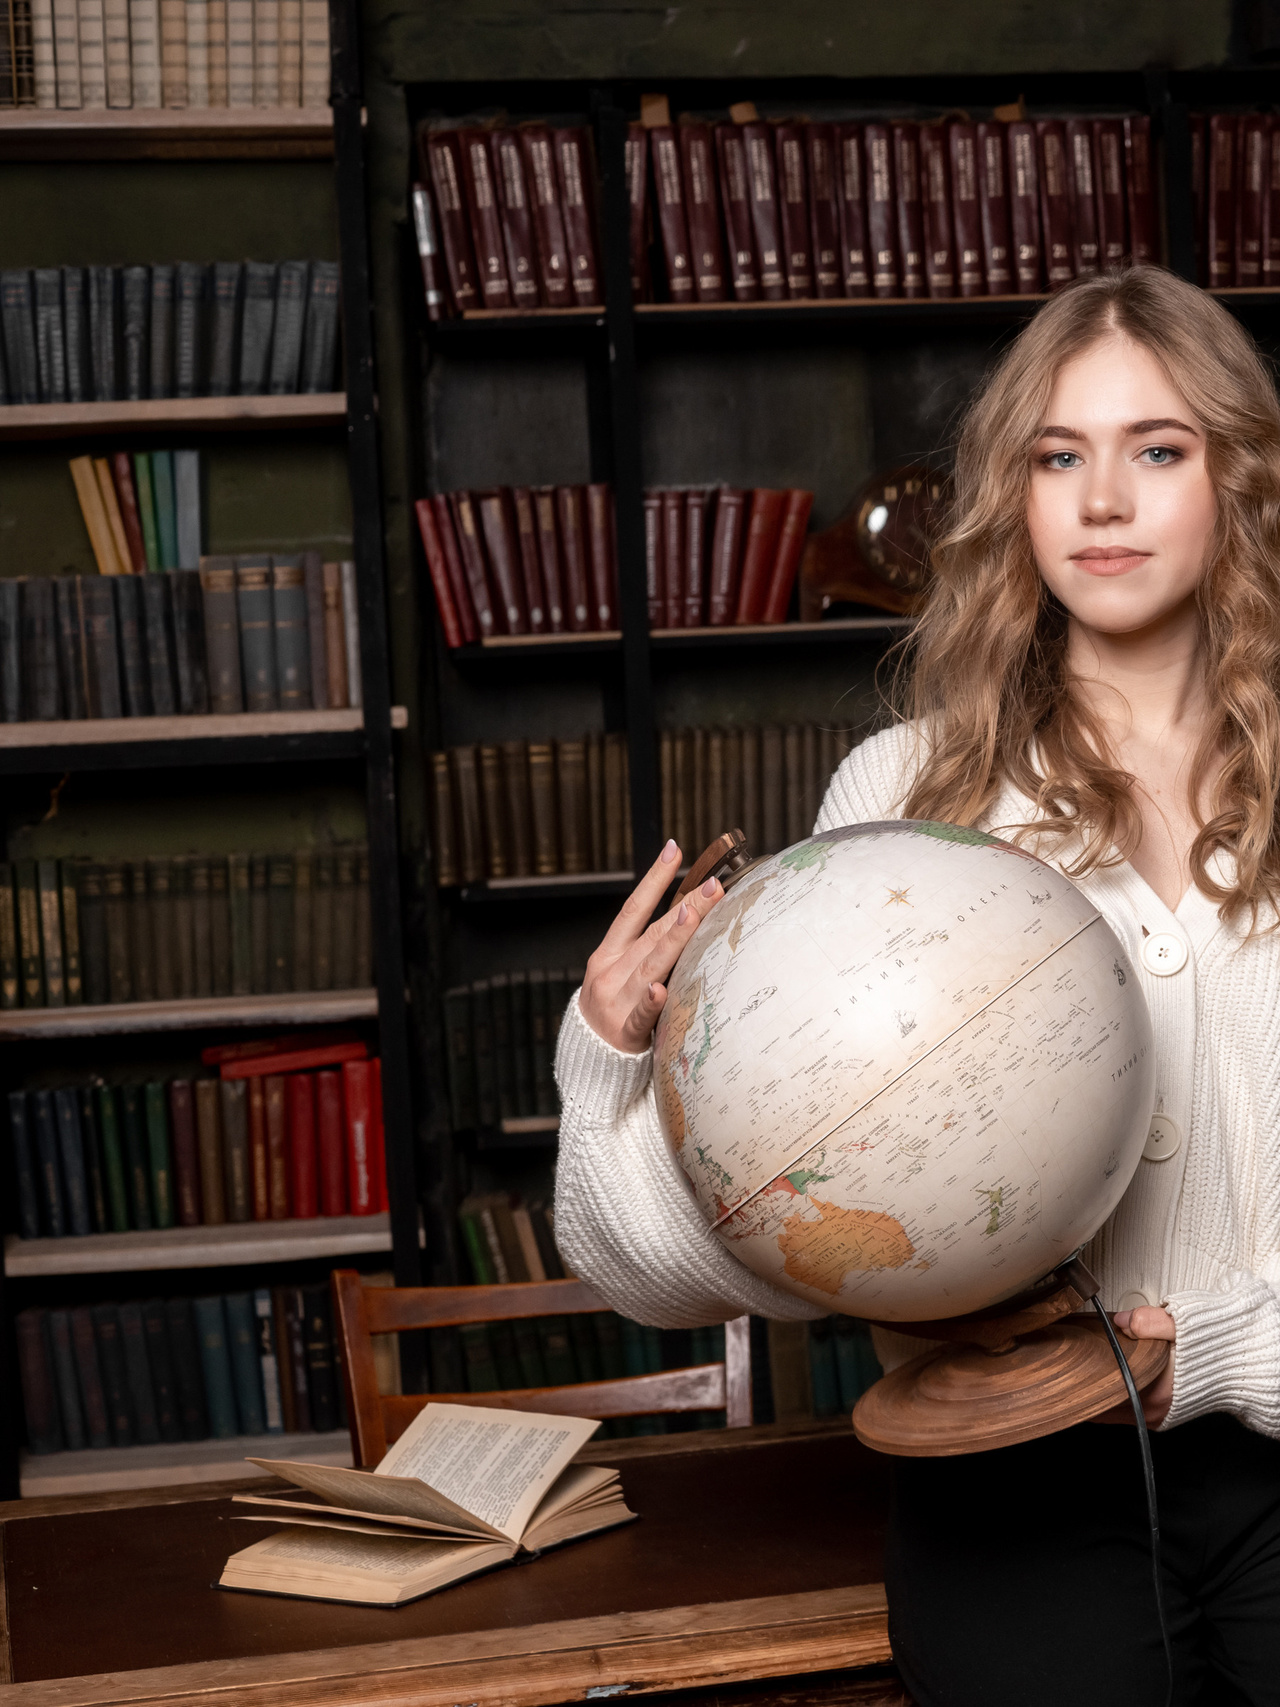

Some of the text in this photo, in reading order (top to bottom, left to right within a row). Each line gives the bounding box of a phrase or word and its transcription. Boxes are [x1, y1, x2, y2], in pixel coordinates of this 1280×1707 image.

[955, 881, 1008, 923] ОКЕАН
[830, 957, 906, 1017] ТИХИЙ
[1111, 1054, 1137, 1082] ТИХИЙ
